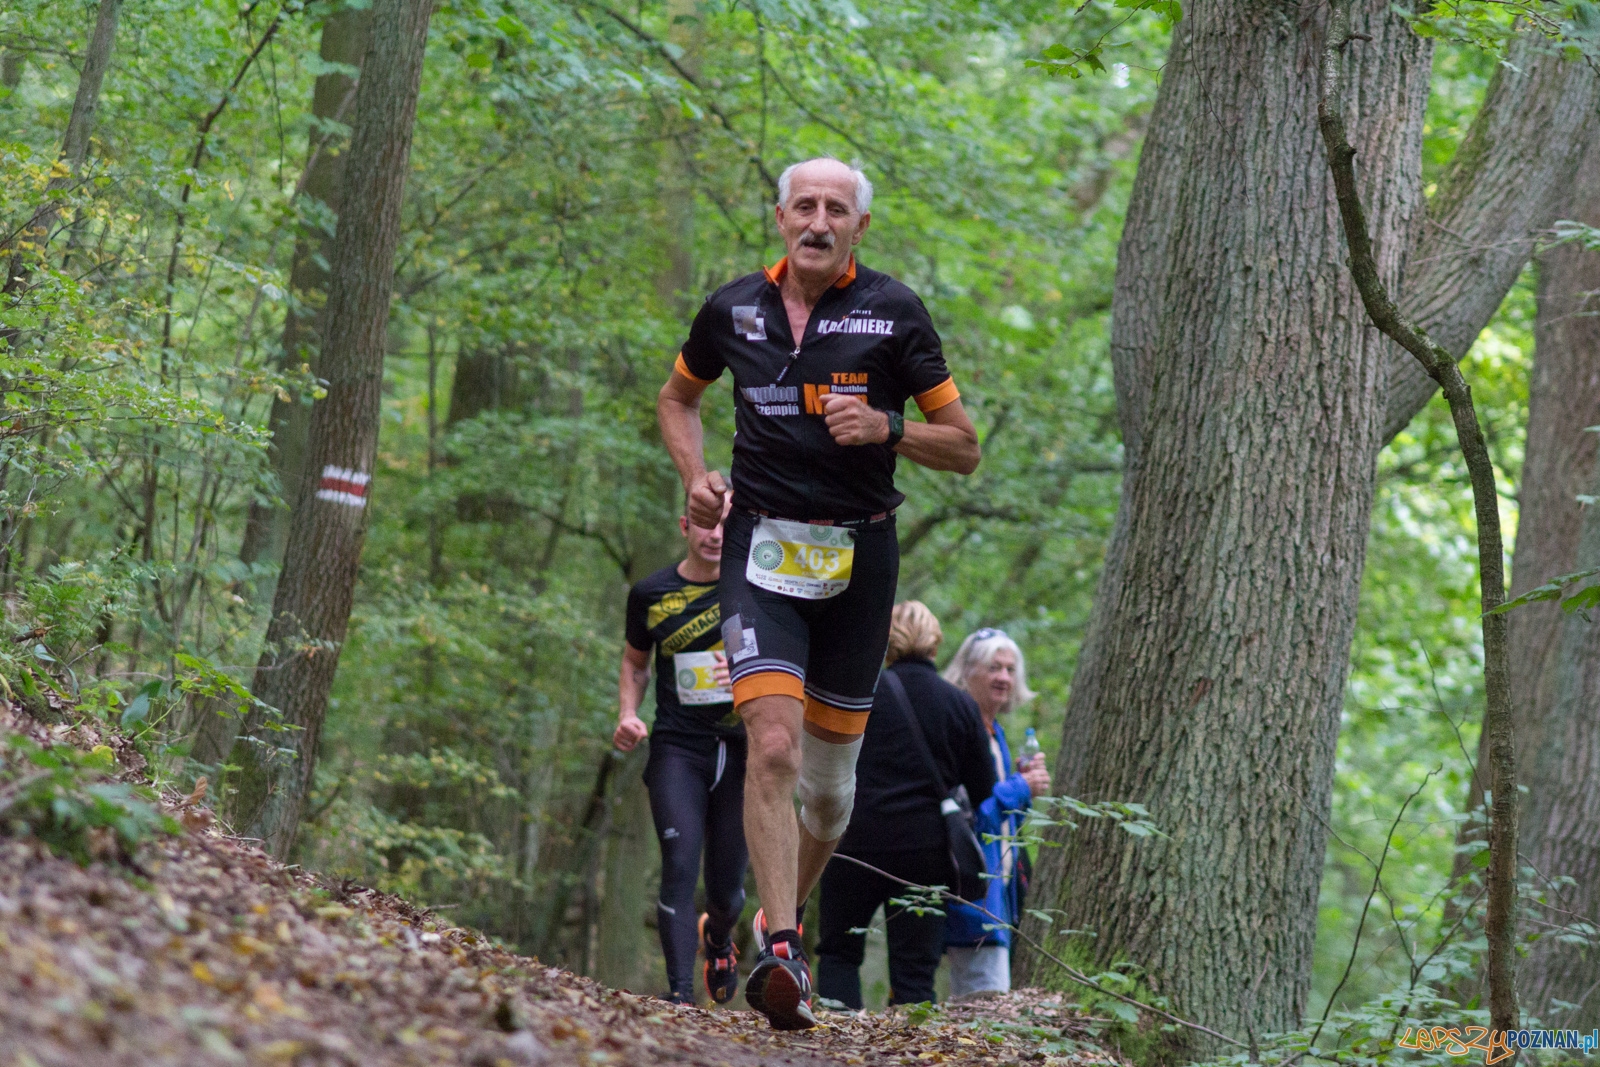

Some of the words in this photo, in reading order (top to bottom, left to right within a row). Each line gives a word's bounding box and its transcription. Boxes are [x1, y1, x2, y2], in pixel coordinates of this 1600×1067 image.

[831, 373, 868, 384] TEAM
[831, 385, 868, 393] Duathlon
[794, 546, 840, 572] 403
